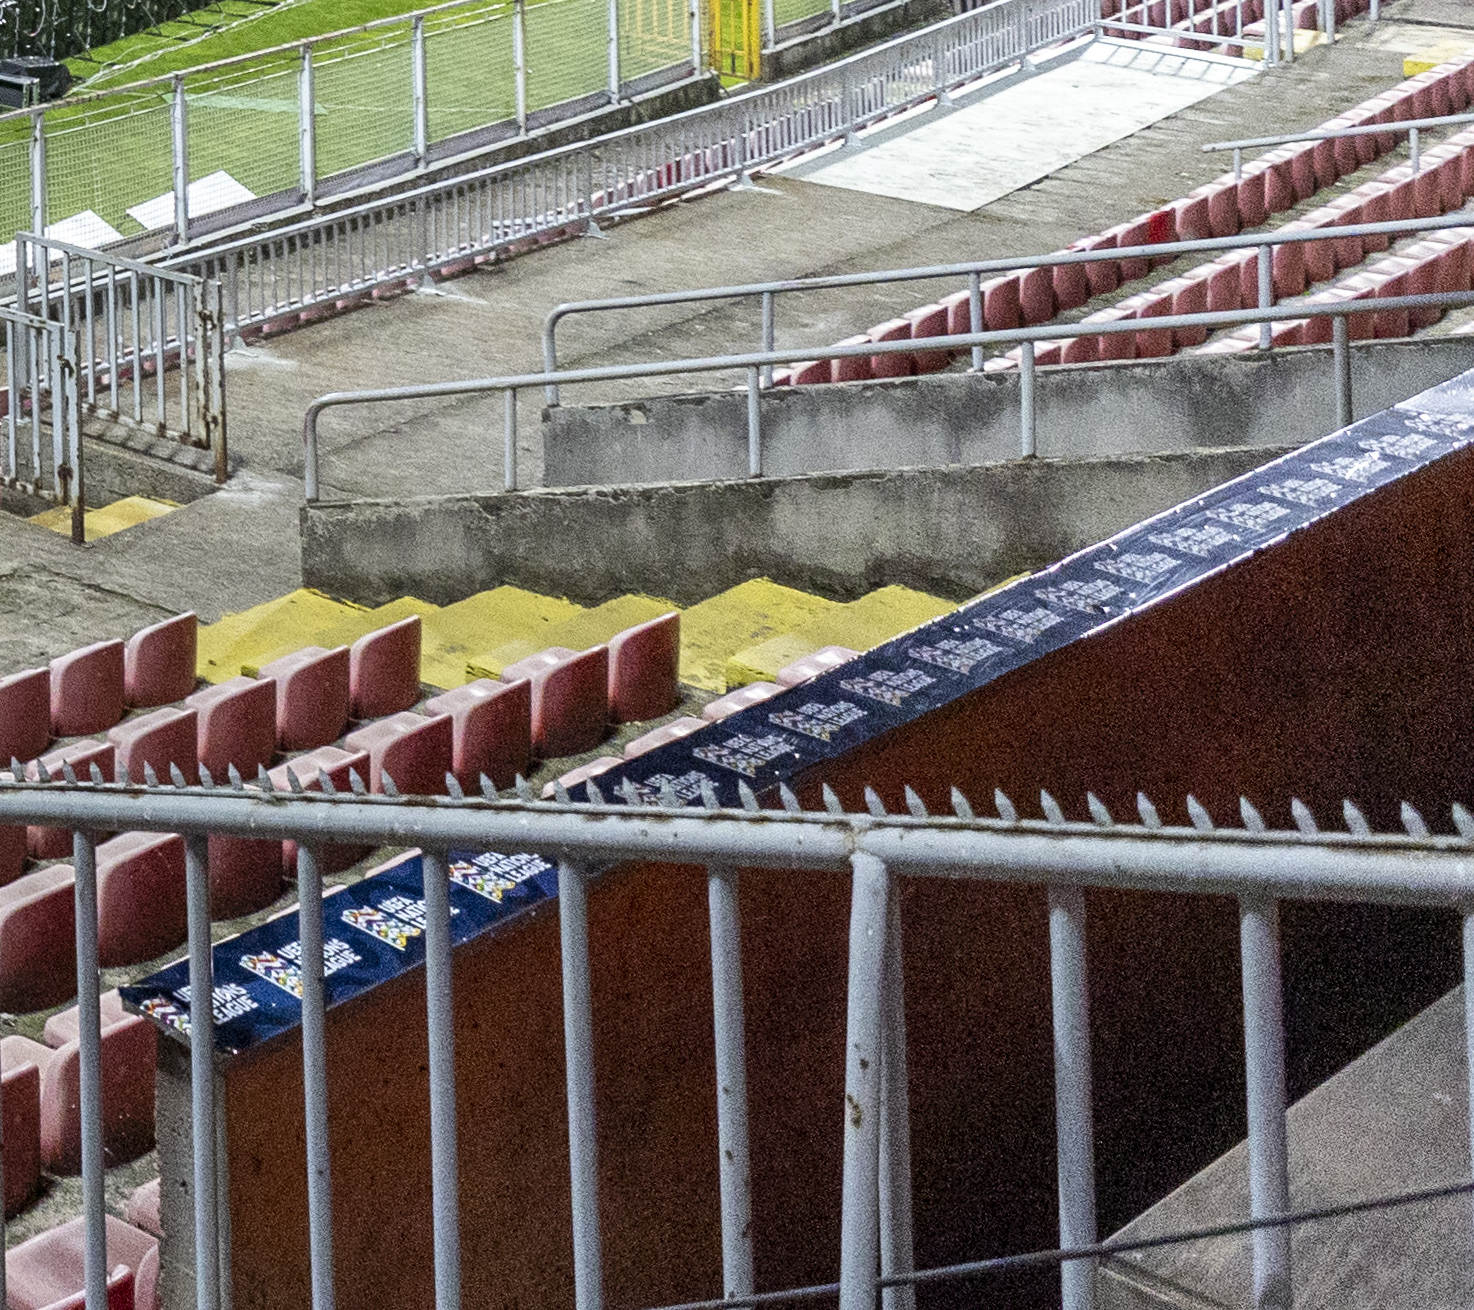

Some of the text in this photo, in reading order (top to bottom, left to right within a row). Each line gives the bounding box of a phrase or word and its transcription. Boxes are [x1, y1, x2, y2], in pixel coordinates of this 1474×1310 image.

[471, 852, 507, 867] UEFA
[504, 859, 551, 883] LEAGUE
[377, 896, 414, 913] UEFA
